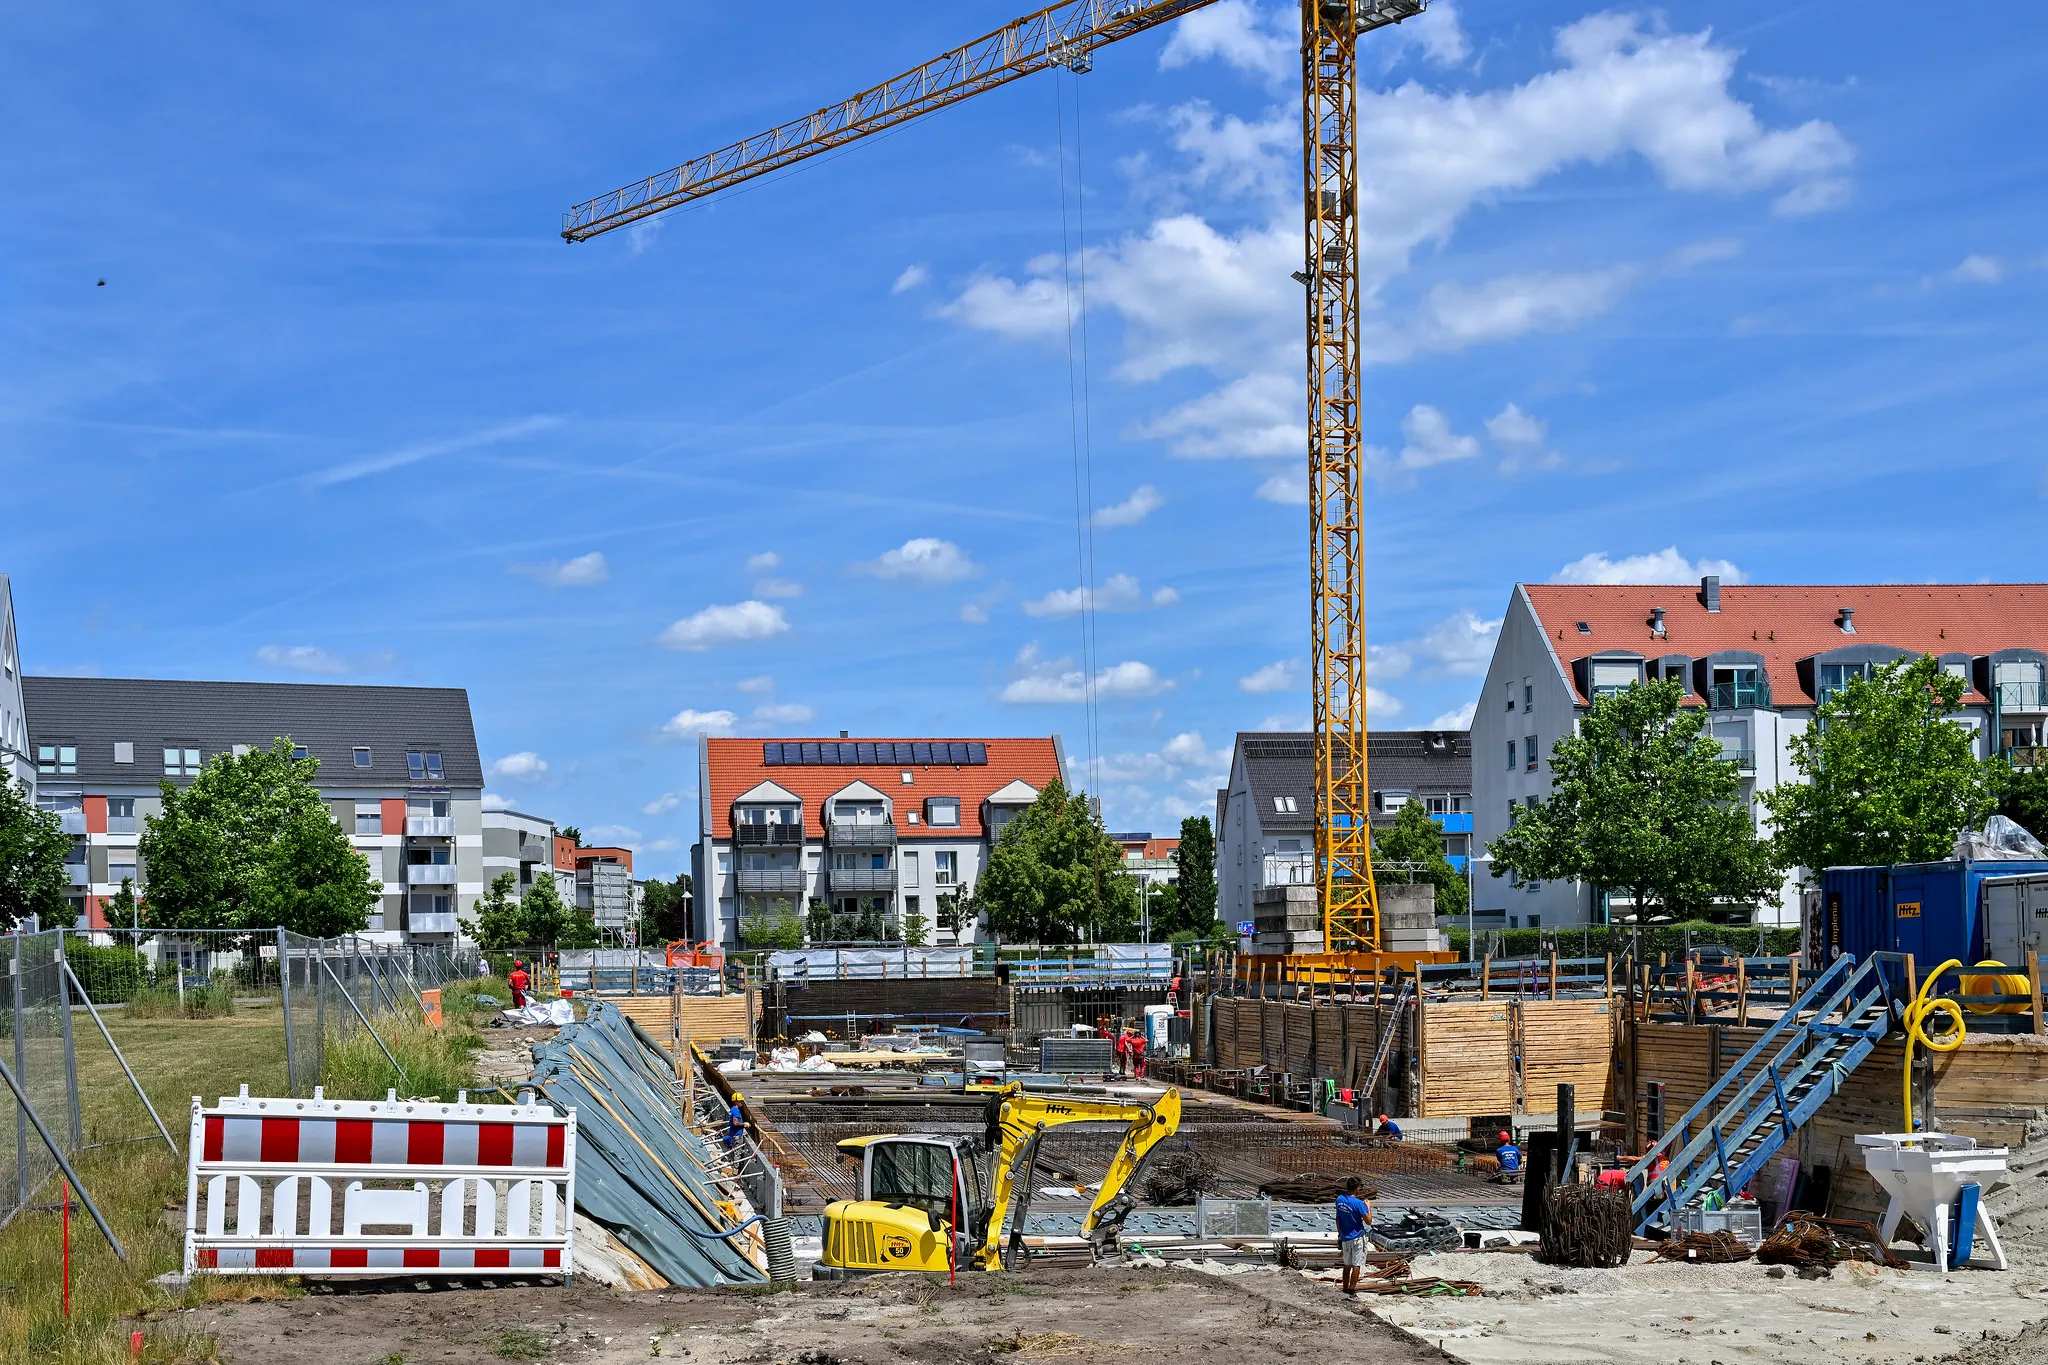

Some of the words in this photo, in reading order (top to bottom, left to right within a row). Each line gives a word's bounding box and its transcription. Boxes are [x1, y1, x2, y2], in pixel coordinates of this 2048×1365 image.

[1898, 904, 1917, 916] Hitz
[2035, 907, 2048, 919] Hit
[1046, 1104, 1072, 1116] Hitz
